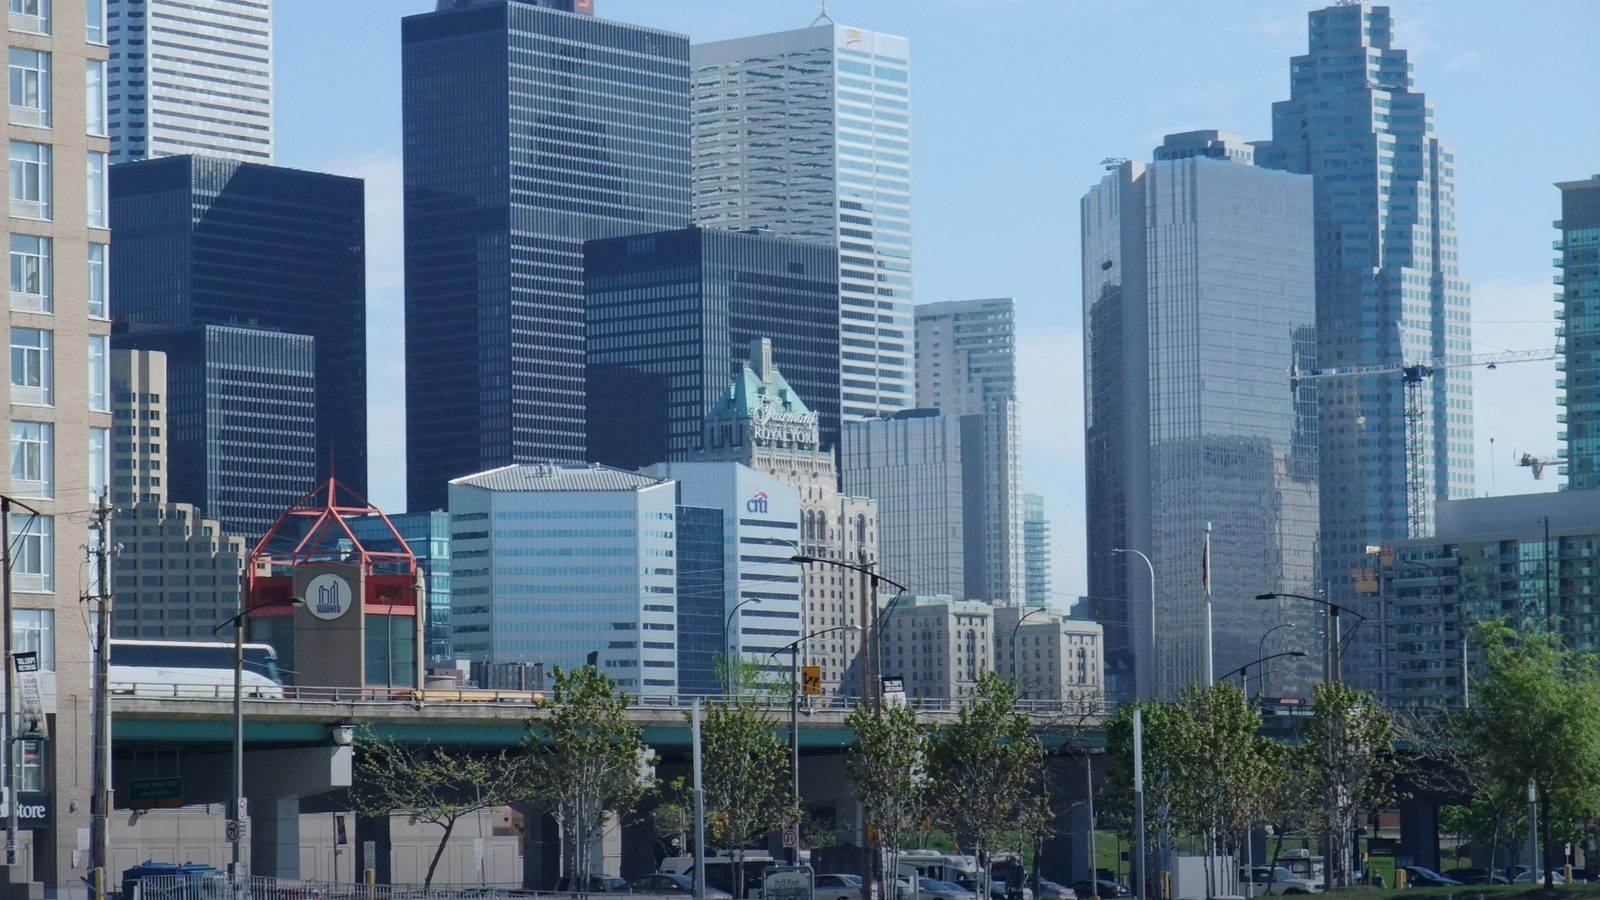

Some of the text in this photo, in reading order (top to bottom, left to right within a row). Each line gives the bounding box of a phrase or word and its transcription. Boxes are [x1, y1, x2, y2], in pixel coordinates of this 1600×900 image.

[754, 425, 818, 444] ROYAL YORK
[746, 495, 768, 514] citi
